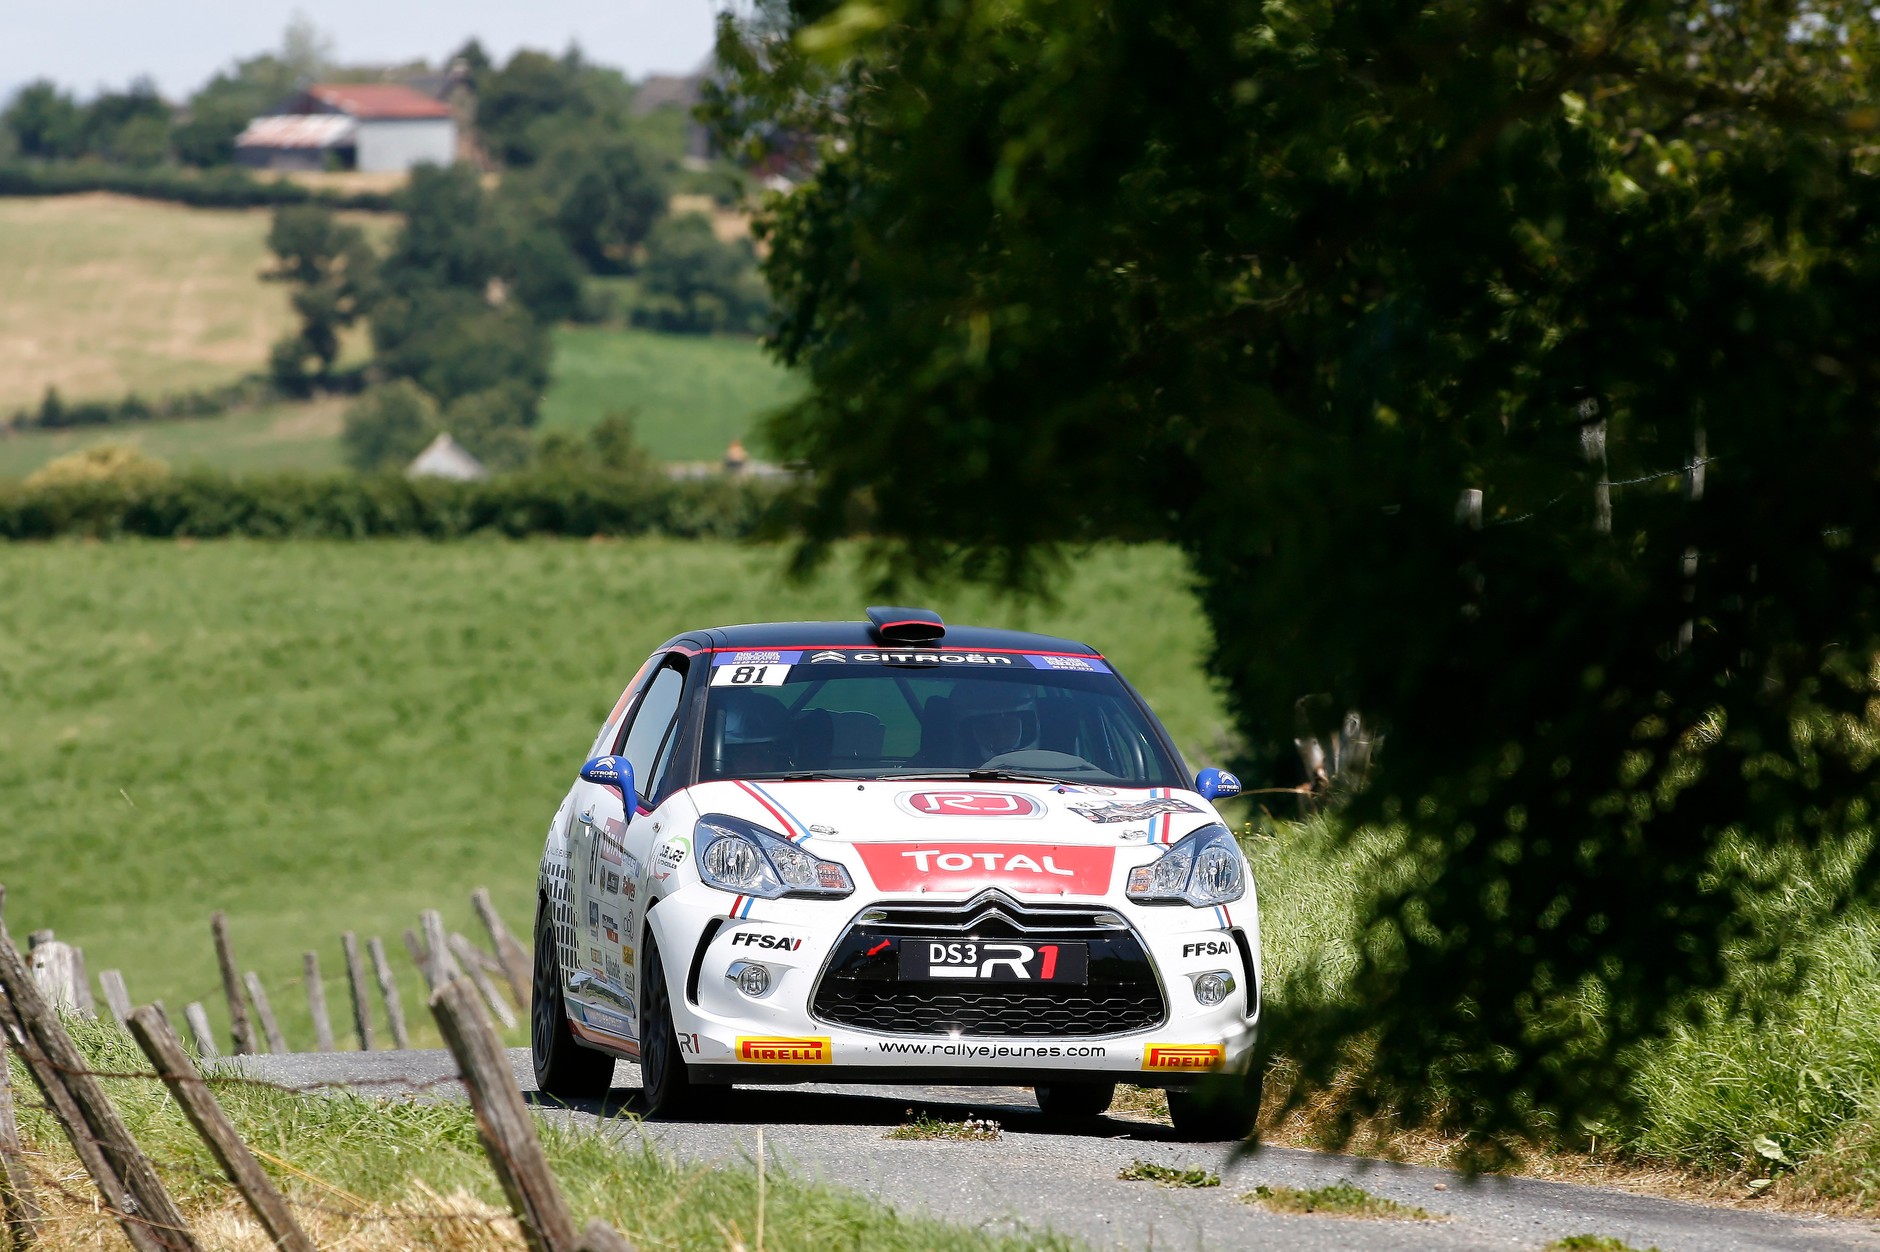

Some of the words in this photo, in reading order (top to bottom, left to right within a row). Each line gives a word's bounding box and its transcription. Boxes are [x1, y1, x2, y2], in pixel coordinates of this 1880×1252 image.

[731, 666, 768, 683] 81
[901, 849, 1074, 876] TOTAL
[731, 932, 791, 951] FFSA
[1182, 941, 1229, 958] FFSA
[929, 943, 977, 964] DS3
[980, 944, 1059, 979] R1
[742, 1041, 822, 1060] PIRELLI
[879, 1042, 1106, 1058] www.rallyejeunes.com
